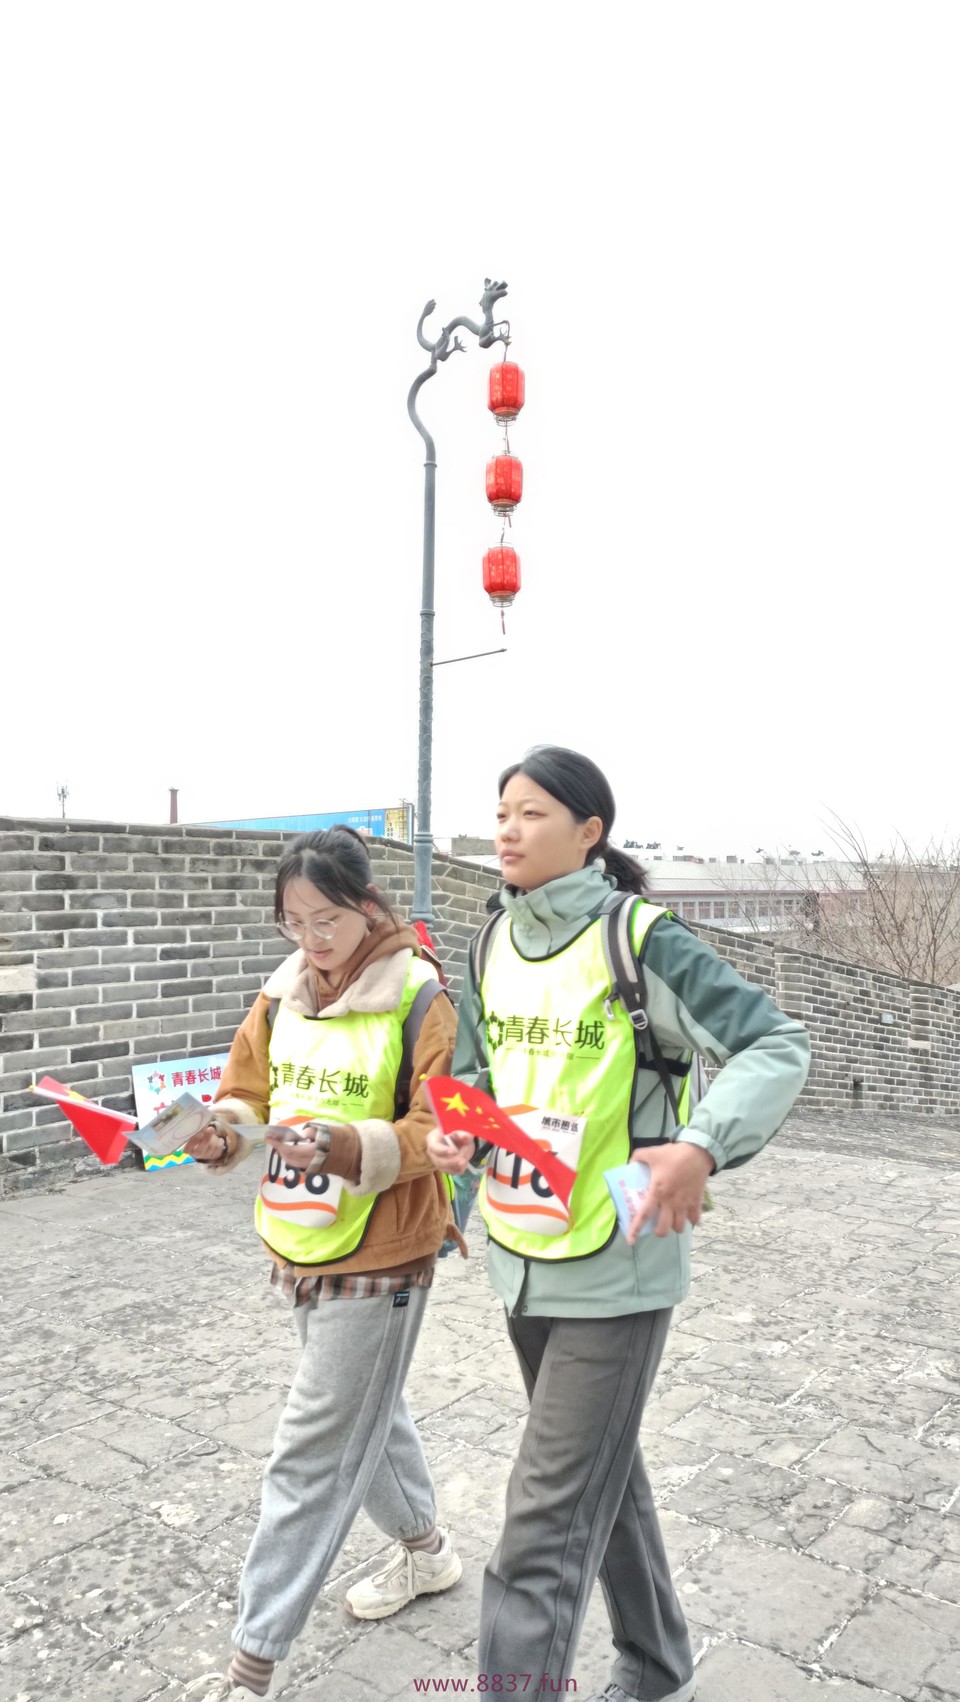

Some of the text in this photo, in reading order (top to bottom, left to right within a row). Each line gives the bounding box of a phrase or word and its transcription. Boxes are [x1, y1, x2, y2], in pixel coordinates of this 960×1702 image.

[504, 1014, 606, 1051] 青春长城
[171, 1066, 222, 1088] 青春长城
[281, 1062, 370, 1099] 青春长城
